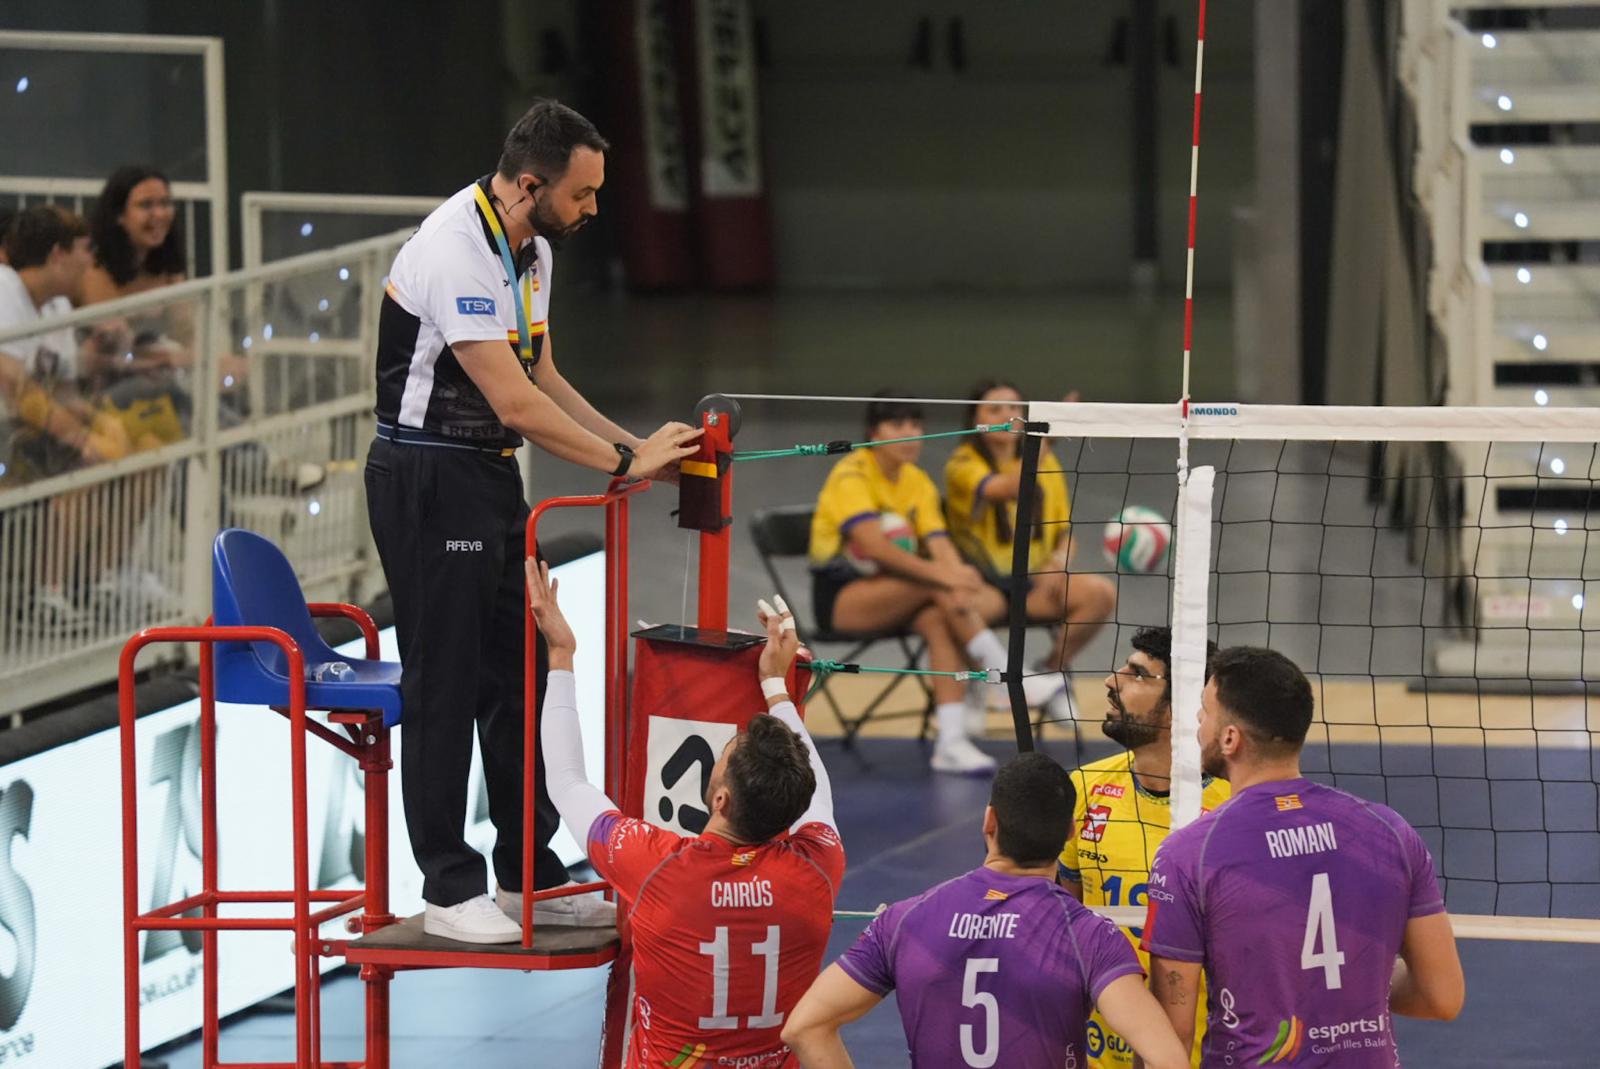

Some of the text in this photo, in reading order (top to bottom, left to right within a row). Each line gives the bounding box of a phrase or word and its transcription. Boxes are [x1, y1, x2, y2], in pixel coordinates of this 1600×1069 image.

[1194, 407, 1238, 416] MONDO
[446, 540, 483, 551] RFEVB
[1265, 822, 1337, 859] ROMANI
[711, 875, 774, 908] CAIRÚS
[948, 912, 1020, 940] LORENTE
[1301, 873, 1345, 990] 4
[698, 925, 784, 1030] 11
[959, 958, 1000, 1069] 5
[1107, 1034, 1133, 1054] GU
